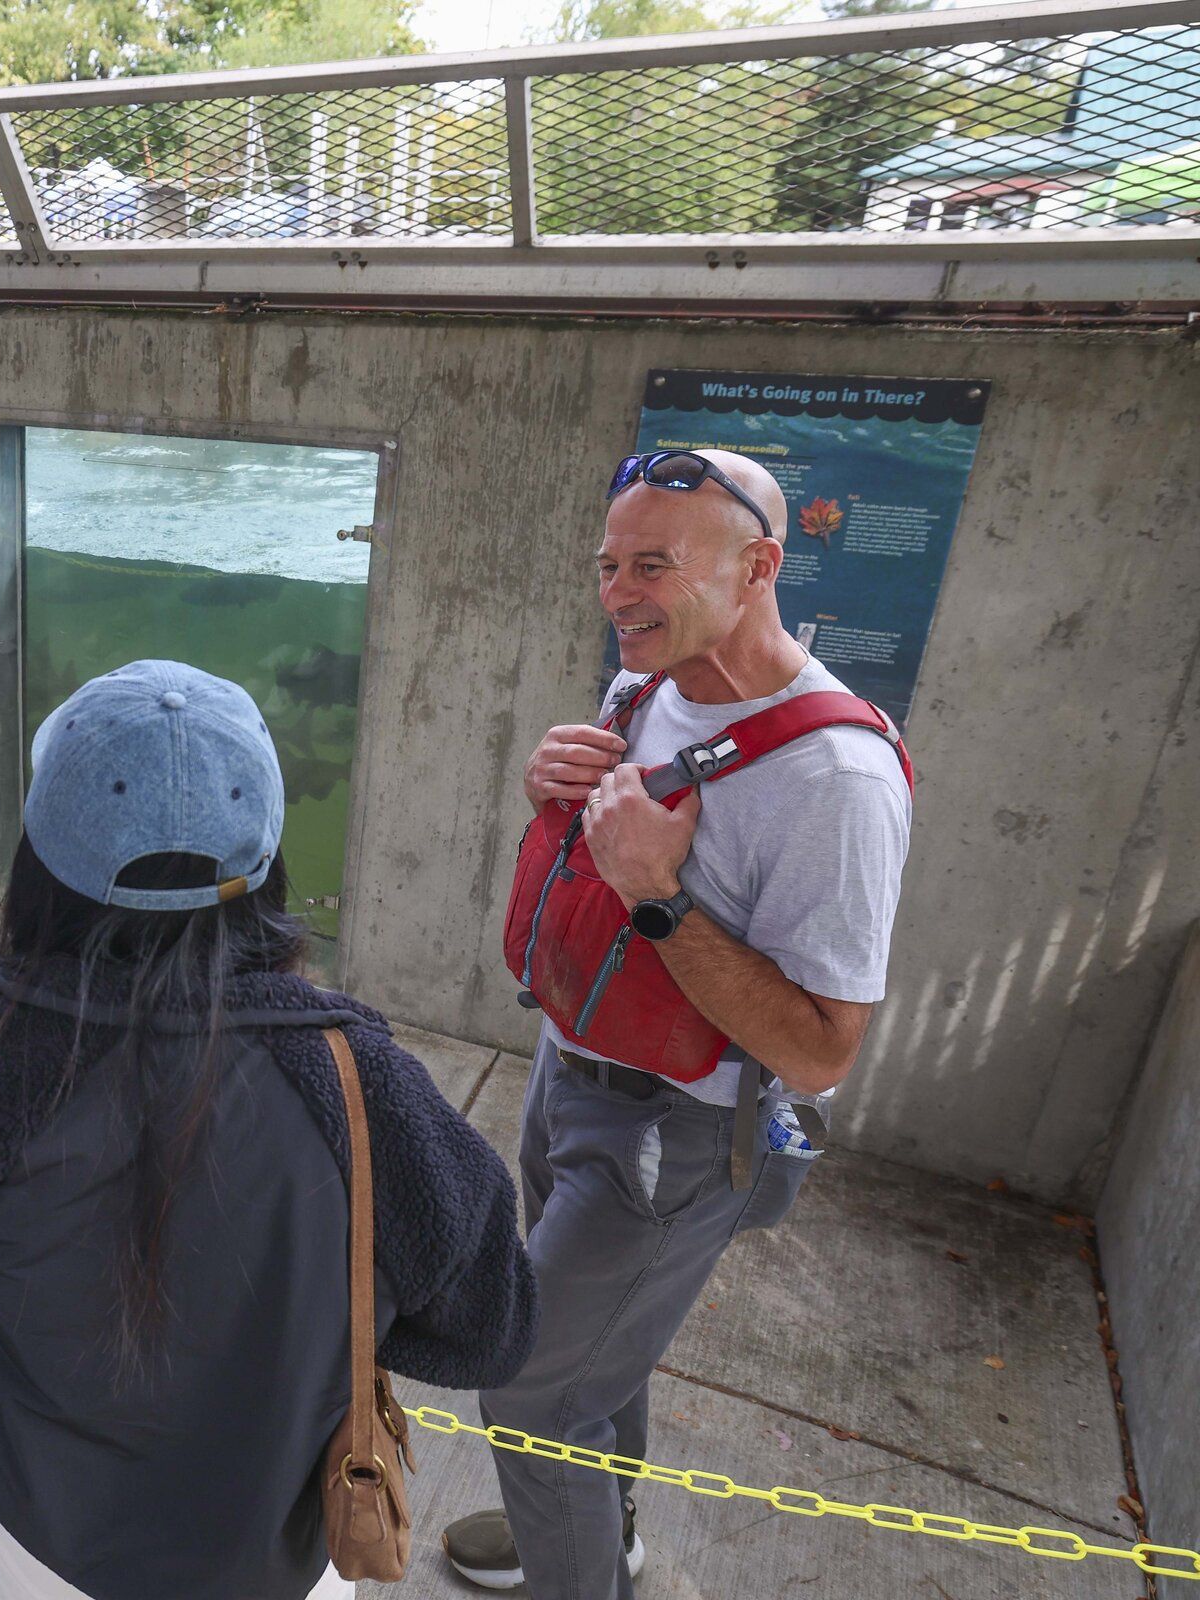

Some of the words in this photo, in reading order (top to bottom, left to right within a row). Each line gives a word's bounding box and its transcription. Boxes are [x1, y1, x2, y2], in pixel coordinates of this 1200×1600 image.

[702, 383, 758, 399] What's
[762, 386, 812, 404] Going
[815, 390, 835, 402] on
[842, 388, 858, 402] in
[864, 390, 926, 406] There?
[657, 438, 690, 449] Salmon
[718, 442, 738, 452] here
[739, 444, 790, 456] seasonally
